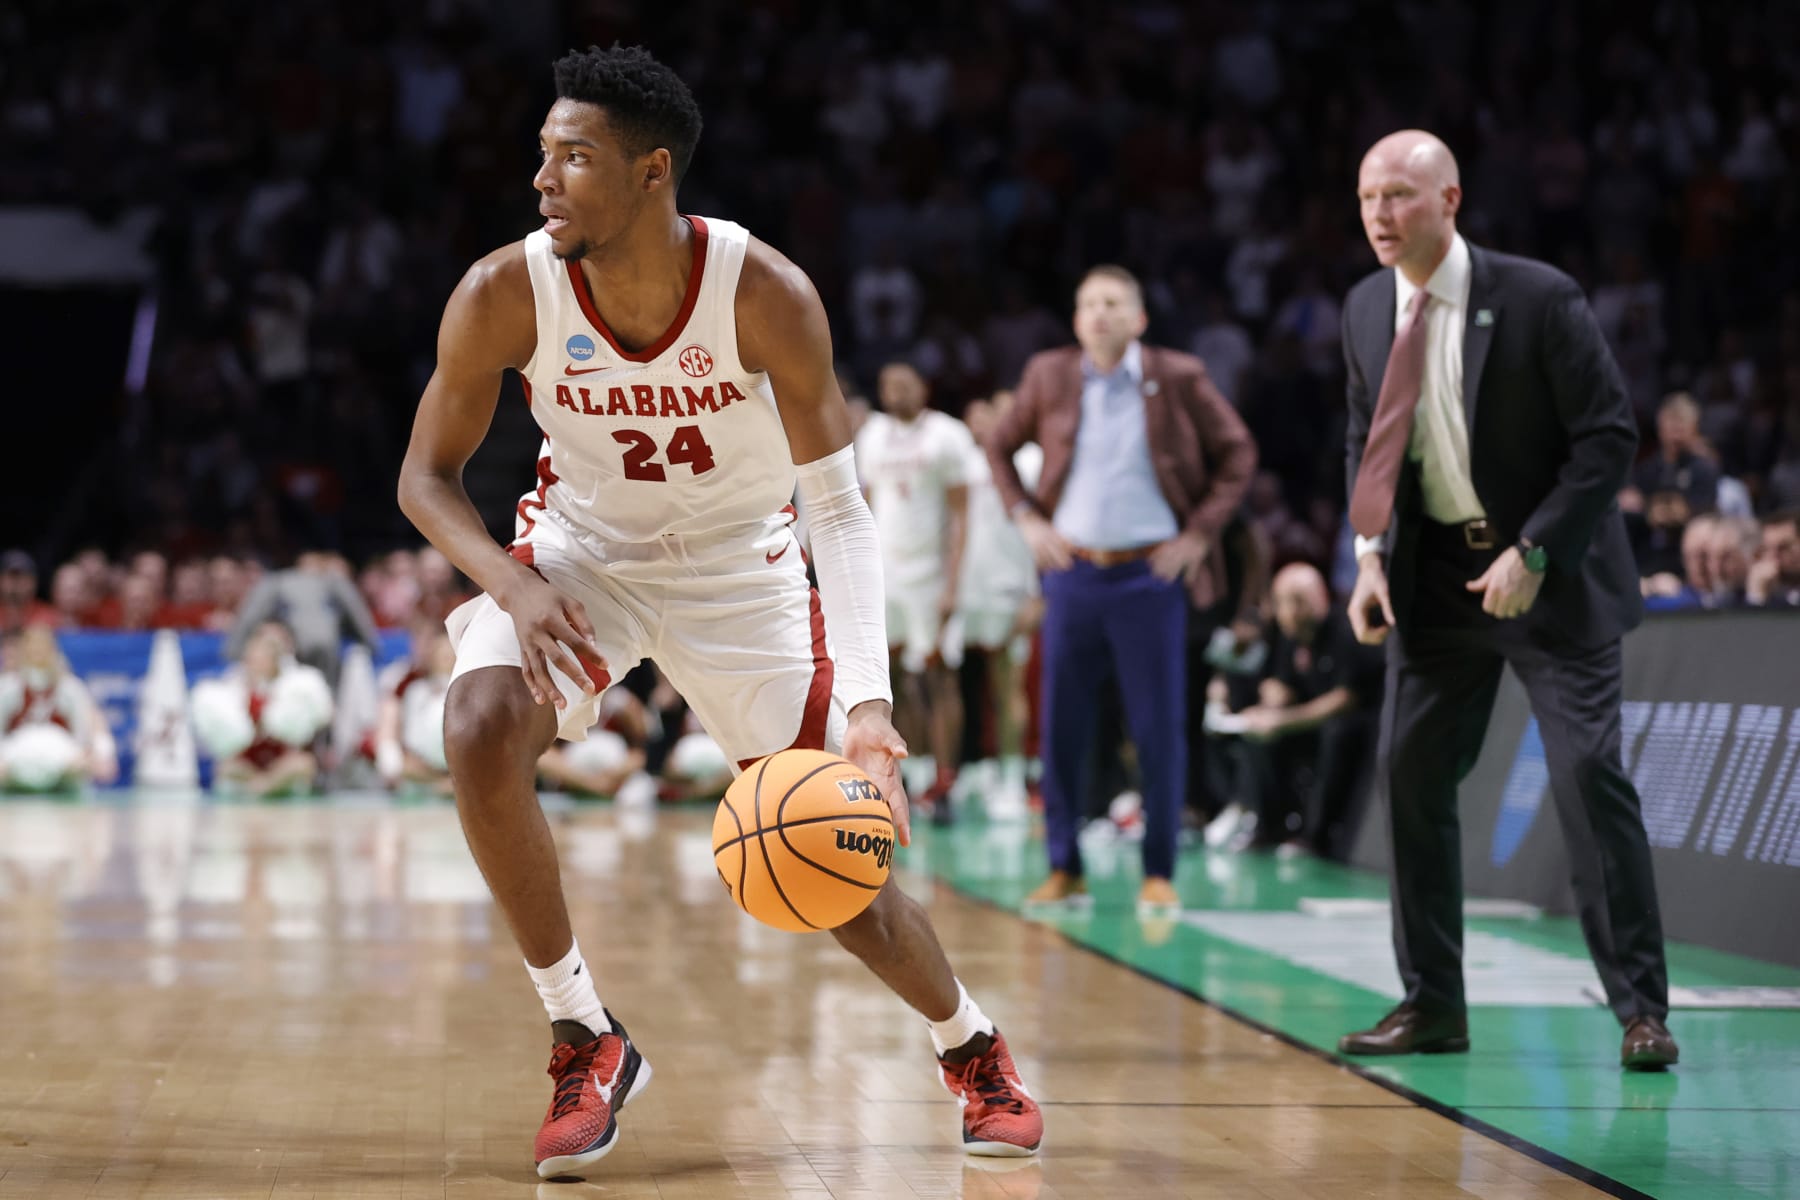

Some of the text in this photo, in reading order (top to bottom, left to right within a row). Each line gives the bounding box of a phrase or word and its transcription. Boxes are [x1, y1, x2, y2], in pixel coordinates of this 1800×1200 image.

[570, 346, 593, 356] NCAA
[680, 348, 713, 376] SEC
[556, 381, 746, 418] ALABAMA
[611, 425, 716, 482] 24
[836, 779, 885, 803] CAA
